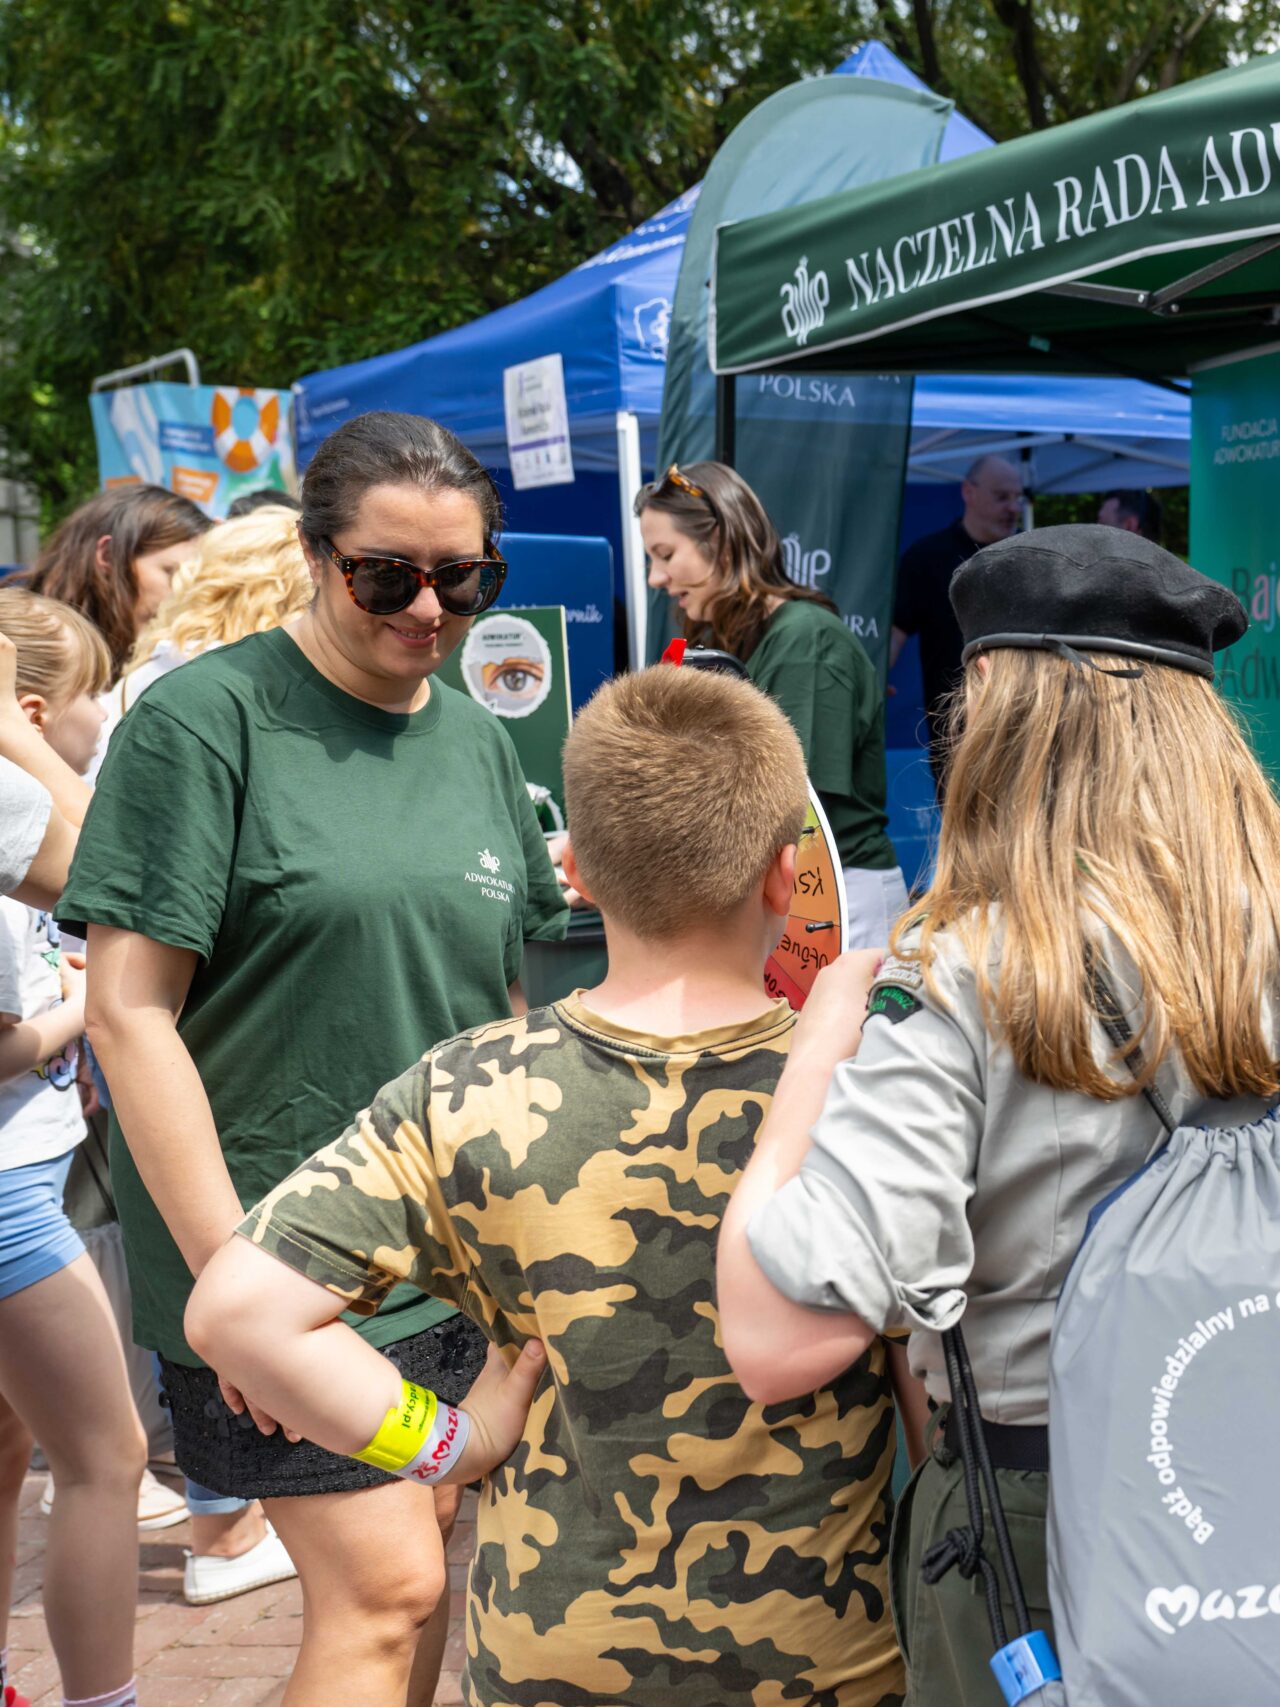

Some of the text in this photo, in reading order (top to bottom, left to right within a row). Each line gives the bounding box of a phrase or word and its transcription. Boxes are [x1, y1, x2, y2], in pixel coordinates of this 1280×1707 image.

[845, 192, 1045, 311] NACZELNA
[1054, 145, 1187, 242] RADA
[759, 374, 856, 407] POLSKA
[481, 887, 510, 903] POLSKA
[1238, 1294, 1270, 1318] na
[1147, 1306, 1236, 1486] odpowiedzialny
[1161, 1486, 1215, 1545] Bądź
